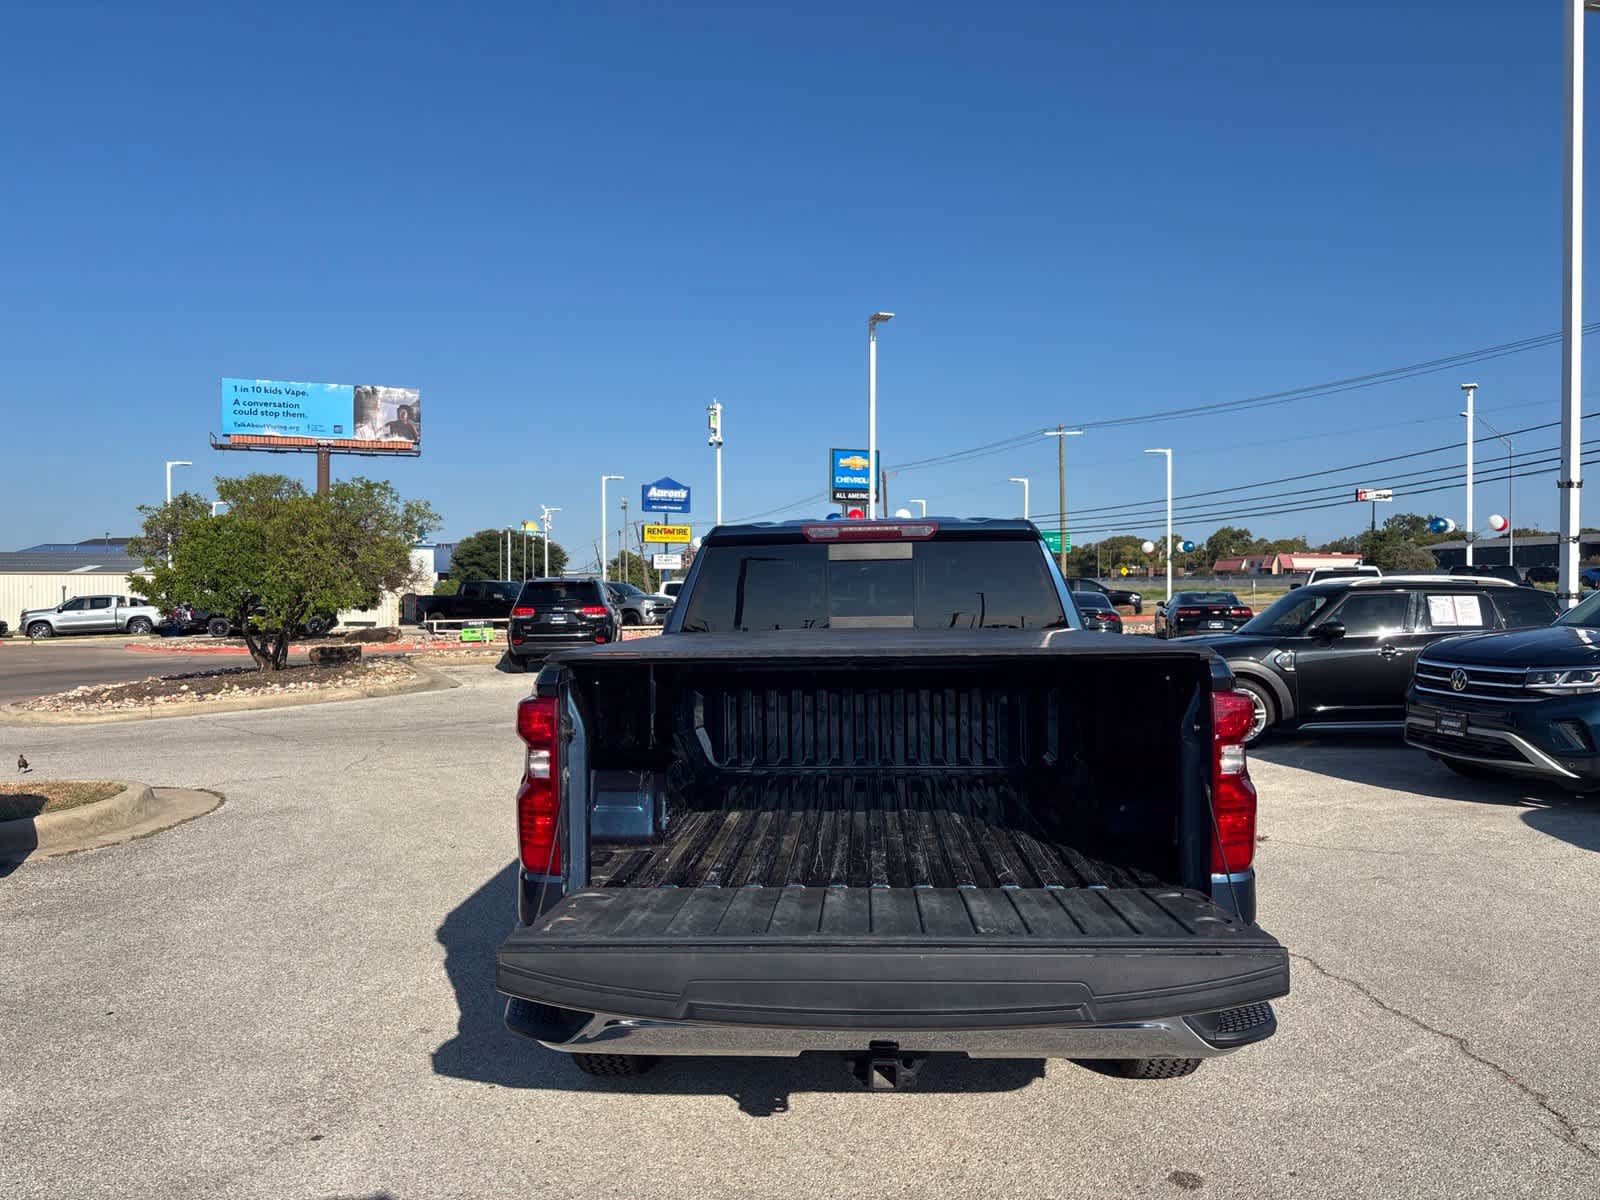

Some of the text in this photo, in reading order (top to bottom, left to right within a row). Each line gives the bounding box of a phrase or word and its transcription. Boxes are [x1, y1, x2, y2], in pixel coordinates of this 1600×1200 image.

[233, 384, 309, 397] 1 in 10 kids Vape.
[233, 398, 300, 409] A conversation
[233, 407, 309, 419] could stop them.
